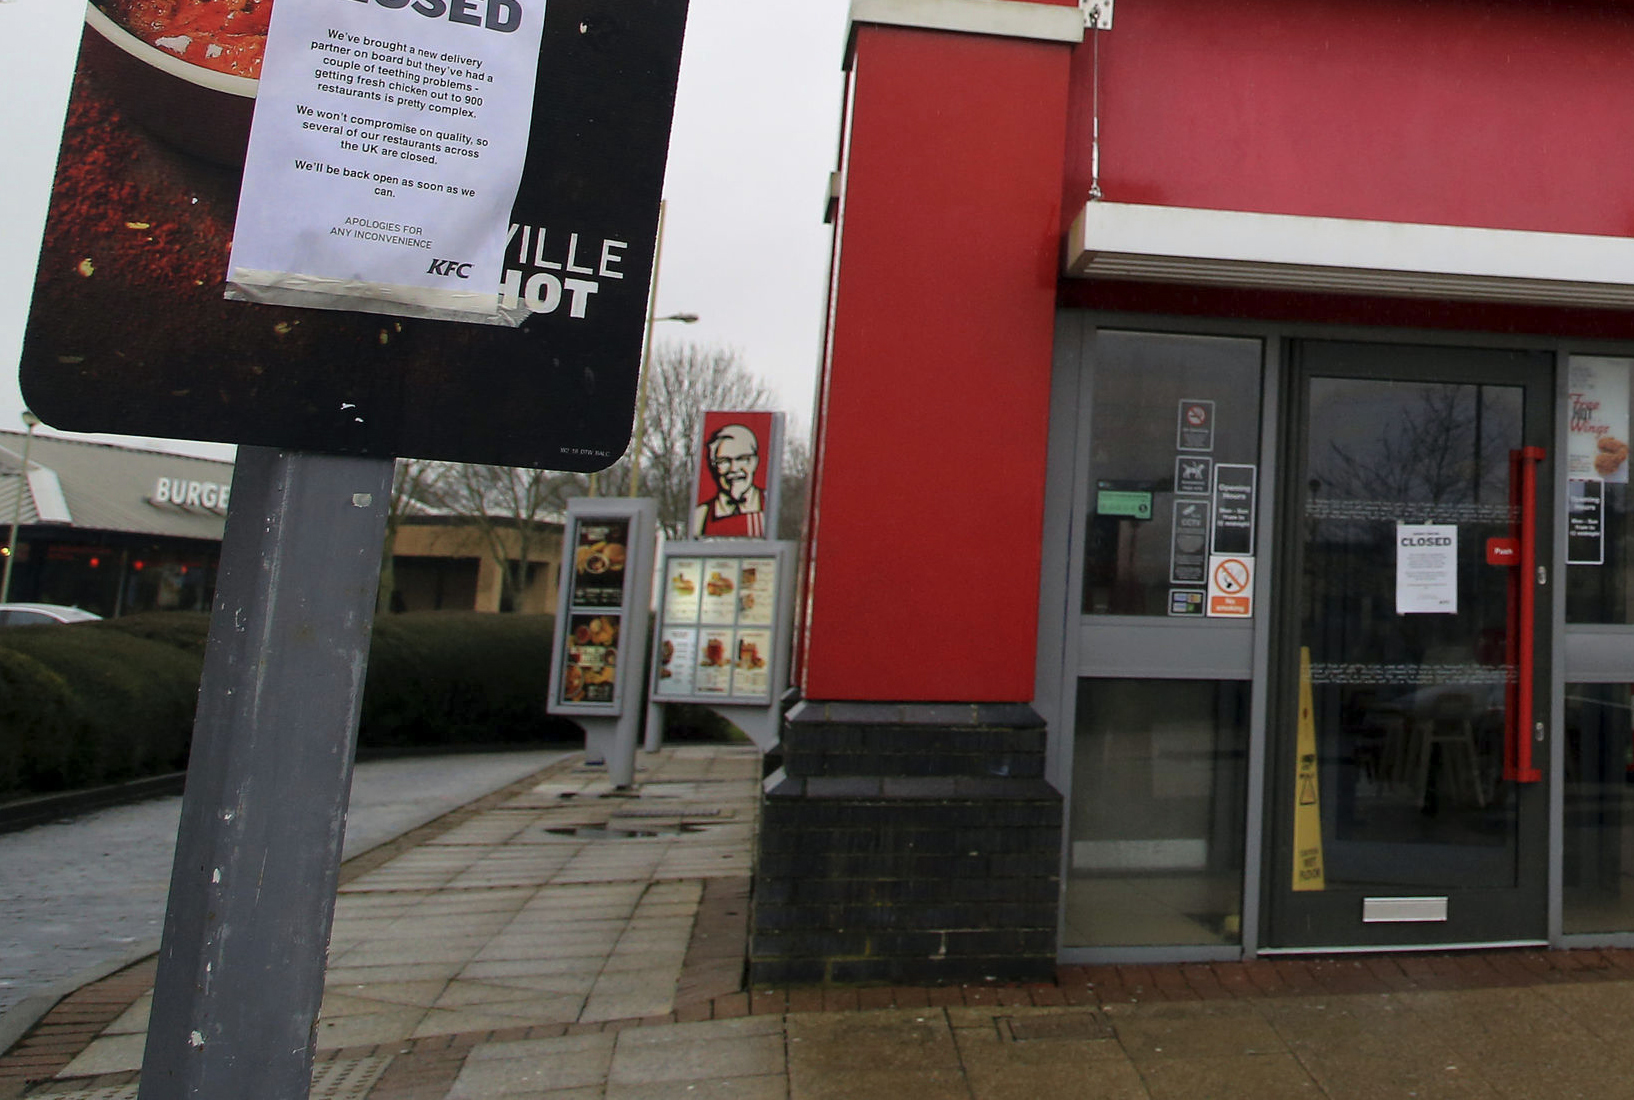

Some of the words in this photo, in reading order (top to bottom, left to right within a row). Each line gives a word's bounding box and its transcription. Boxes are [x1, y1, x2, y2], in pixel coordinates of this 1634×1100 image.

[311, 40, 351, 57] partner
[354, 48, 368, 58] on
[372, 50, 404, 66] board
[407, 58, 422, 70] but
[424, 60, 464, 78] they've
[466, 68, 485, 81] had
[328, 28, 360, 44] We've
[364, 36, 407, 54] brought
[409, 46, 415, 54] a
[418, 48, 438, 60] new
[440, 52, 483, 69] delivery
[314, 68, 354, 85] getting
[357, 75, 386, 89] fresh
[388, 81, 428, 96] chicken
[430, 90, 448, 101] out
[451, 94, 462, 103] to
[464, 96, 484, 106] 900
[323, 56, 361, 72] couple
[364, 63, 376, 73] of
[378, 66, 420, 84] teething
[423, 75, 473, 91] problems
[318, 82, 382, 101] restaurants
[384, 93, 394, 102] is
[398, 98, 426, 111] pretty
[428, 103, 477, 118] complex.
[296, 105, 314, 116] We
[316, 110, 348, 122] won't
[350, 114, 417, 135] compromise
[420, 128, 433, 138] on
[436, 130, 474, 146] quality,
[476, 138, 489, 147] so
[302, 120, 344, 135] several
[346, 126, 358, 138] of
[360, 130, 380, 140] our
[382, 134, 442, 152] restaurants
[444, 146, 480, 159] across
[340, 140, 359, 152] the
[362, 144, 378, 154] UK
[381, 147, 399, 158] are
[400, 151, 438, 164] closed.
[295, 160, 323, 173] We'll
[326, 164, 340, 176] be
[342, 167, 370, 180] back
[373, 173, 399, 186] open
[402, 178, 414, 187] as
[416, 180, 444, 192] soon
[446, 186, 458, 194] as
[461, 188, 476, 198] we
[374, 186, 396, 198] can.
[330, 226, 352, 237] ANY
[354, 230, 433, 250] INCONVENIENCE
[344, 216, 401, 233] APOLOGIES
[402, 224, 423, 236] FOR
[426, 258, 475, 279] KFC
[156, 477, 231, 507] BURGE
[1401, 537, 1452, 547] CLOSED
